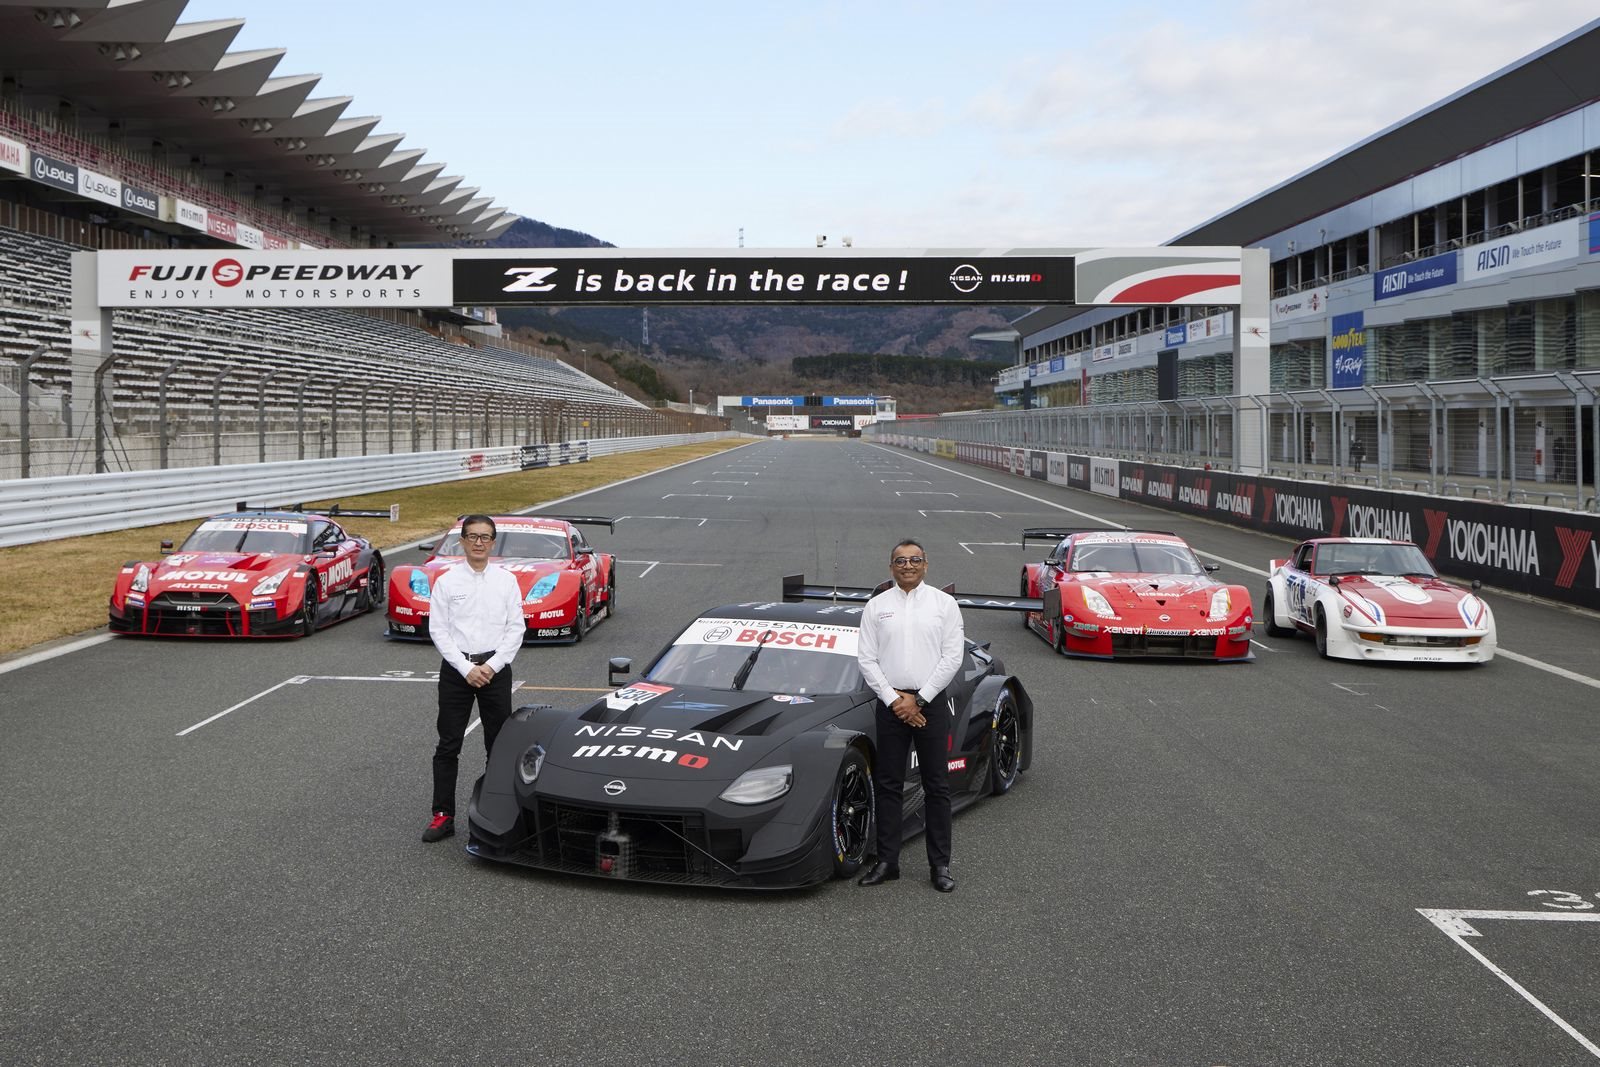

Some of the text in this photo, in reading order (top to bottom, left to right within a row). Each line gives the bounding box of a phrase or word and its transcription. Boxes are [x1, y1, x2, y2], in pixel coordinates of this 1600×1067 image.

[46, 165, 74, 185] LEXUS
[92, 182, 117, 198] LEXUS
[133, 194, 156, 211] LEXUS
[208, 218, 236, 239] NISSAN
[1477, 244, 1510, 272] AISIN
[129, 265, 207, 281] FUJI
[575, 269, 602, 292] is
[615, 268, 695, 292] back
[707, 269, 737, 292] in
[750, 269, 805, 292] the
[1382, 271, 1407, 294] AISIN
[130, 289, 420, 299] ENJOY! MOTORSPORTS
[1121, 476, 1143, 493] ADVAN
[1148, 480, 1173, 500] ADVAN
[1178, 486, 1209, 507] ADVAN
[1215, 492, 1252, 516] ADVAN
[1275, 493, 1324, 531] YOKOHAMA
[1347, 503, 1412, 542] YOKOHAMA
[1447, 517, 1541, 576] YOKOHAMA
[158, 571, 249, 583] MOTUL
[327, 558, 353, 587] MOTUL
[395, 606, 413, 615] MOTUL
[539, 609, 565, 619] MOTUL
[735, 620, 816, 631] NISSAN
[736, 629, 838, 649] BOSCH
[574, 725, 744, 751] NISSAN
[572, 745, 709, 769] nismo
